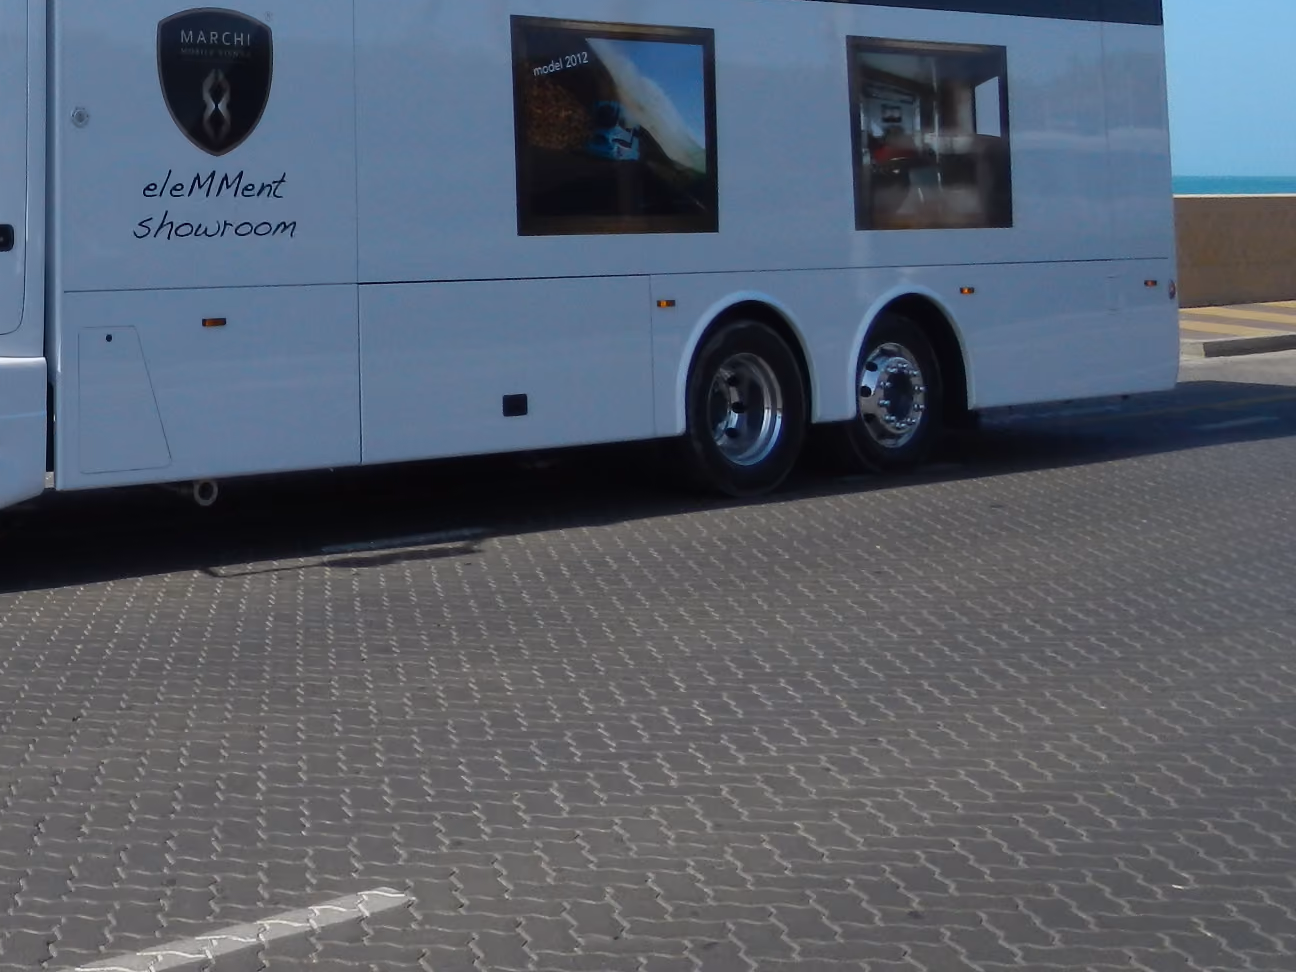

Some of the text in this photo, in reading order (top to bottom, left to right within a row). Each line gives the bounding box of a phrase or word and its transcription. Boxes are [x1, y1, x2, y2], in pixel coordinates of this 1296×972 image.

[180, 29, 250, 46] MARCHI
[533, 51, 589, 76] model 2012
[142, 169, 286, 198] eleMMent
[133, 210, 296, 240] showroom
